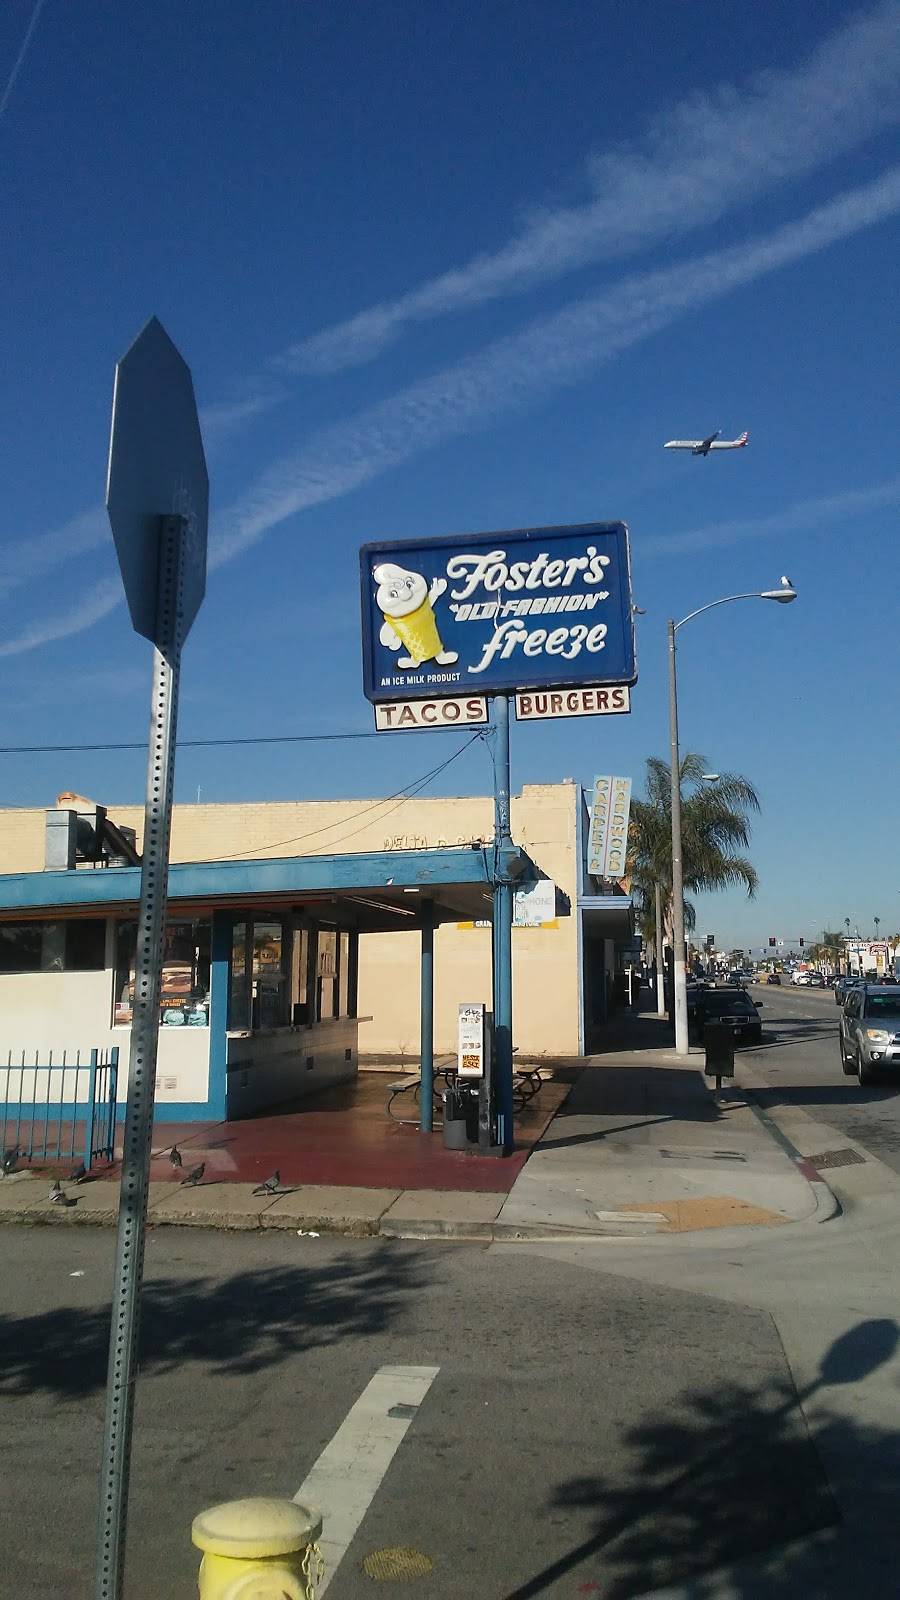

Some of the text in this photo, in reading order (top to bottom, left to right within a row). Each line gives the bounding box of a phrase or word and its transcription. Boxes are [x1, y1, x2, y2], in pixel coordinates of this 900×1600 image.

[446, 546, 611, 601] Foster's
[467, 619, 608, 673] freeze
[381, 672, 461, 686] AN ICE MILK PRODUCT
[379, 699, 484, 726] TACOS
[519, 689, 625, 716] BURGERS
[592, 779, 608, 855] CARPET
